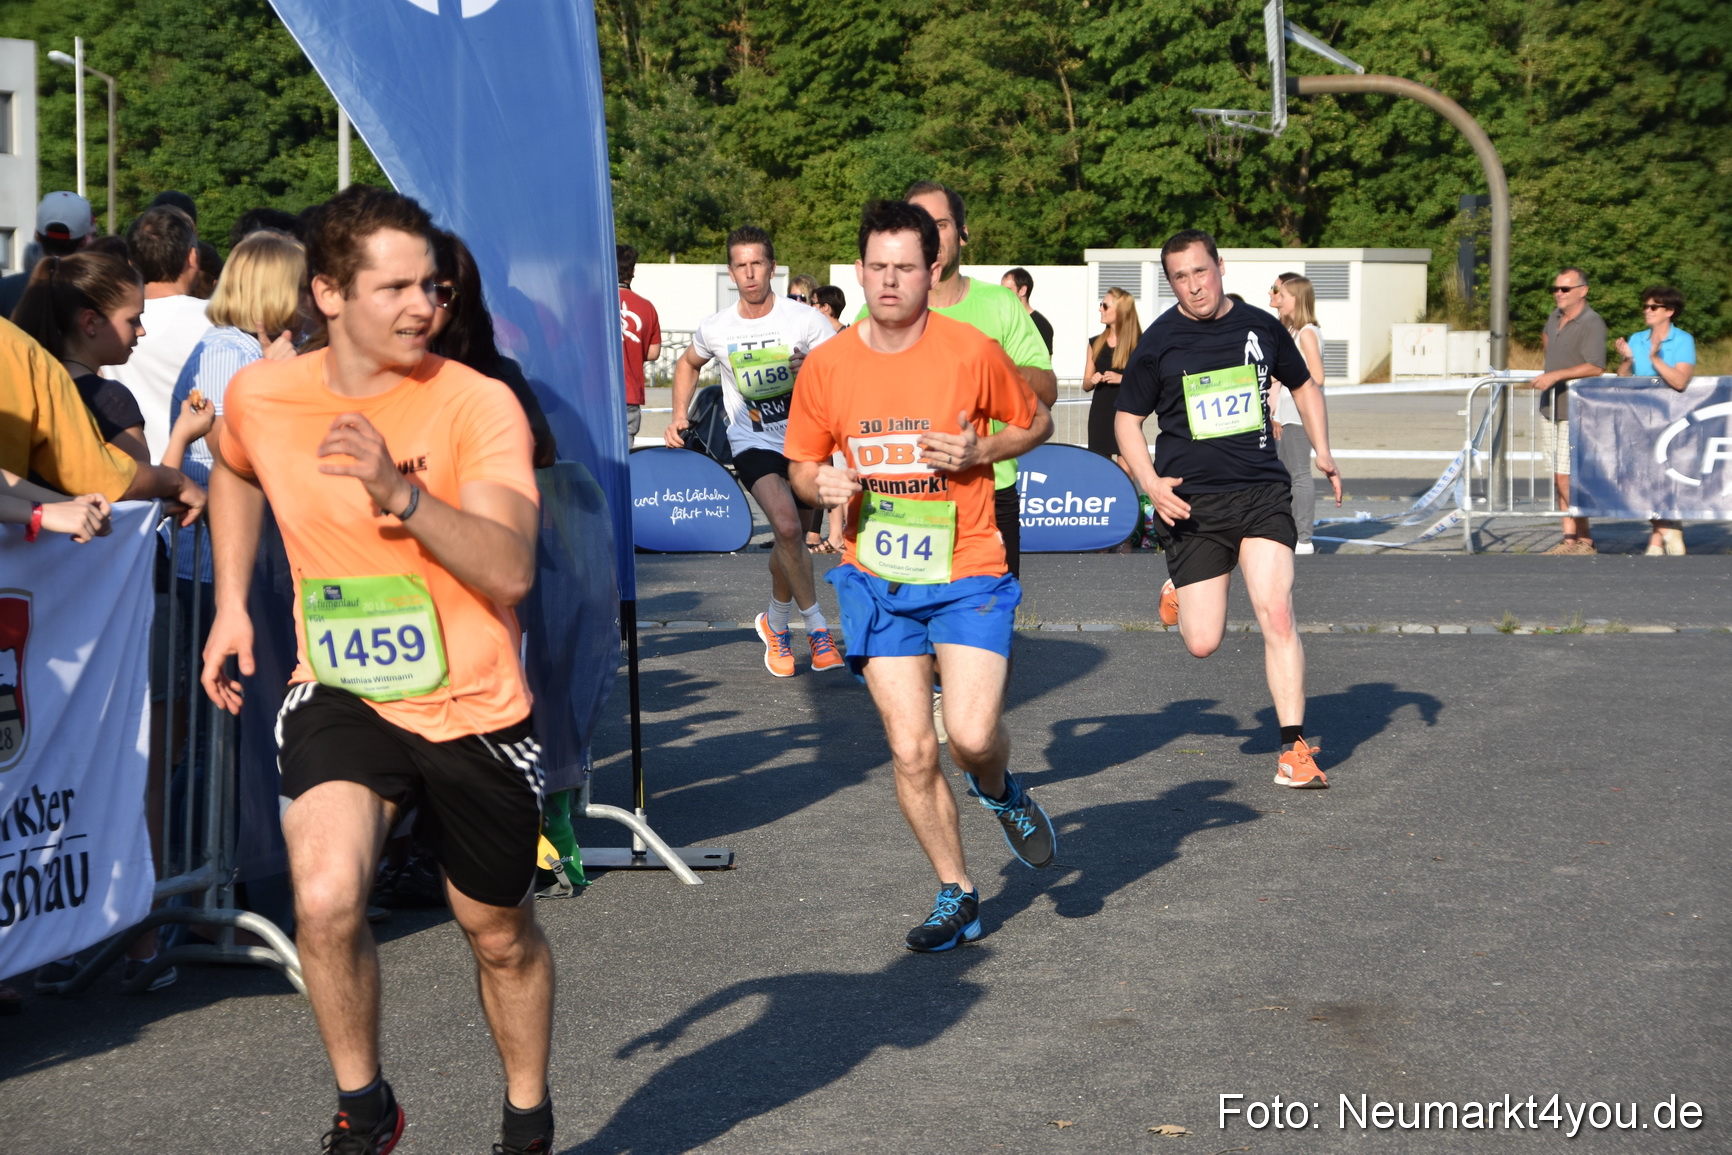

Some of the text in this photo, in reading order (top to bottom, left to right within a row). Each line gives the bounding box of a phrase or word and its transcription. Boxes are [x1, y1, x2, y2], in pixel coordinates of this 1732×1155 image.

[742, 366, 789, 387] 1158
[1196, 392, 1252, 420] 1127
[860, 417, 930, 434] 30 Jahre
[857, 443, 928, 467] OB
[634, 487, 730, 507] und das Lächeln
[1018, 491, 1117, 515] ischer
[670, 505, 730, 525] fährt mit!
[875, 530, 933, 560] 614
[878, 561, 904, 570] Christian
[319, 624, 426, 668] 1459
[340, 673, 414, 685] Matthias Wittmann
